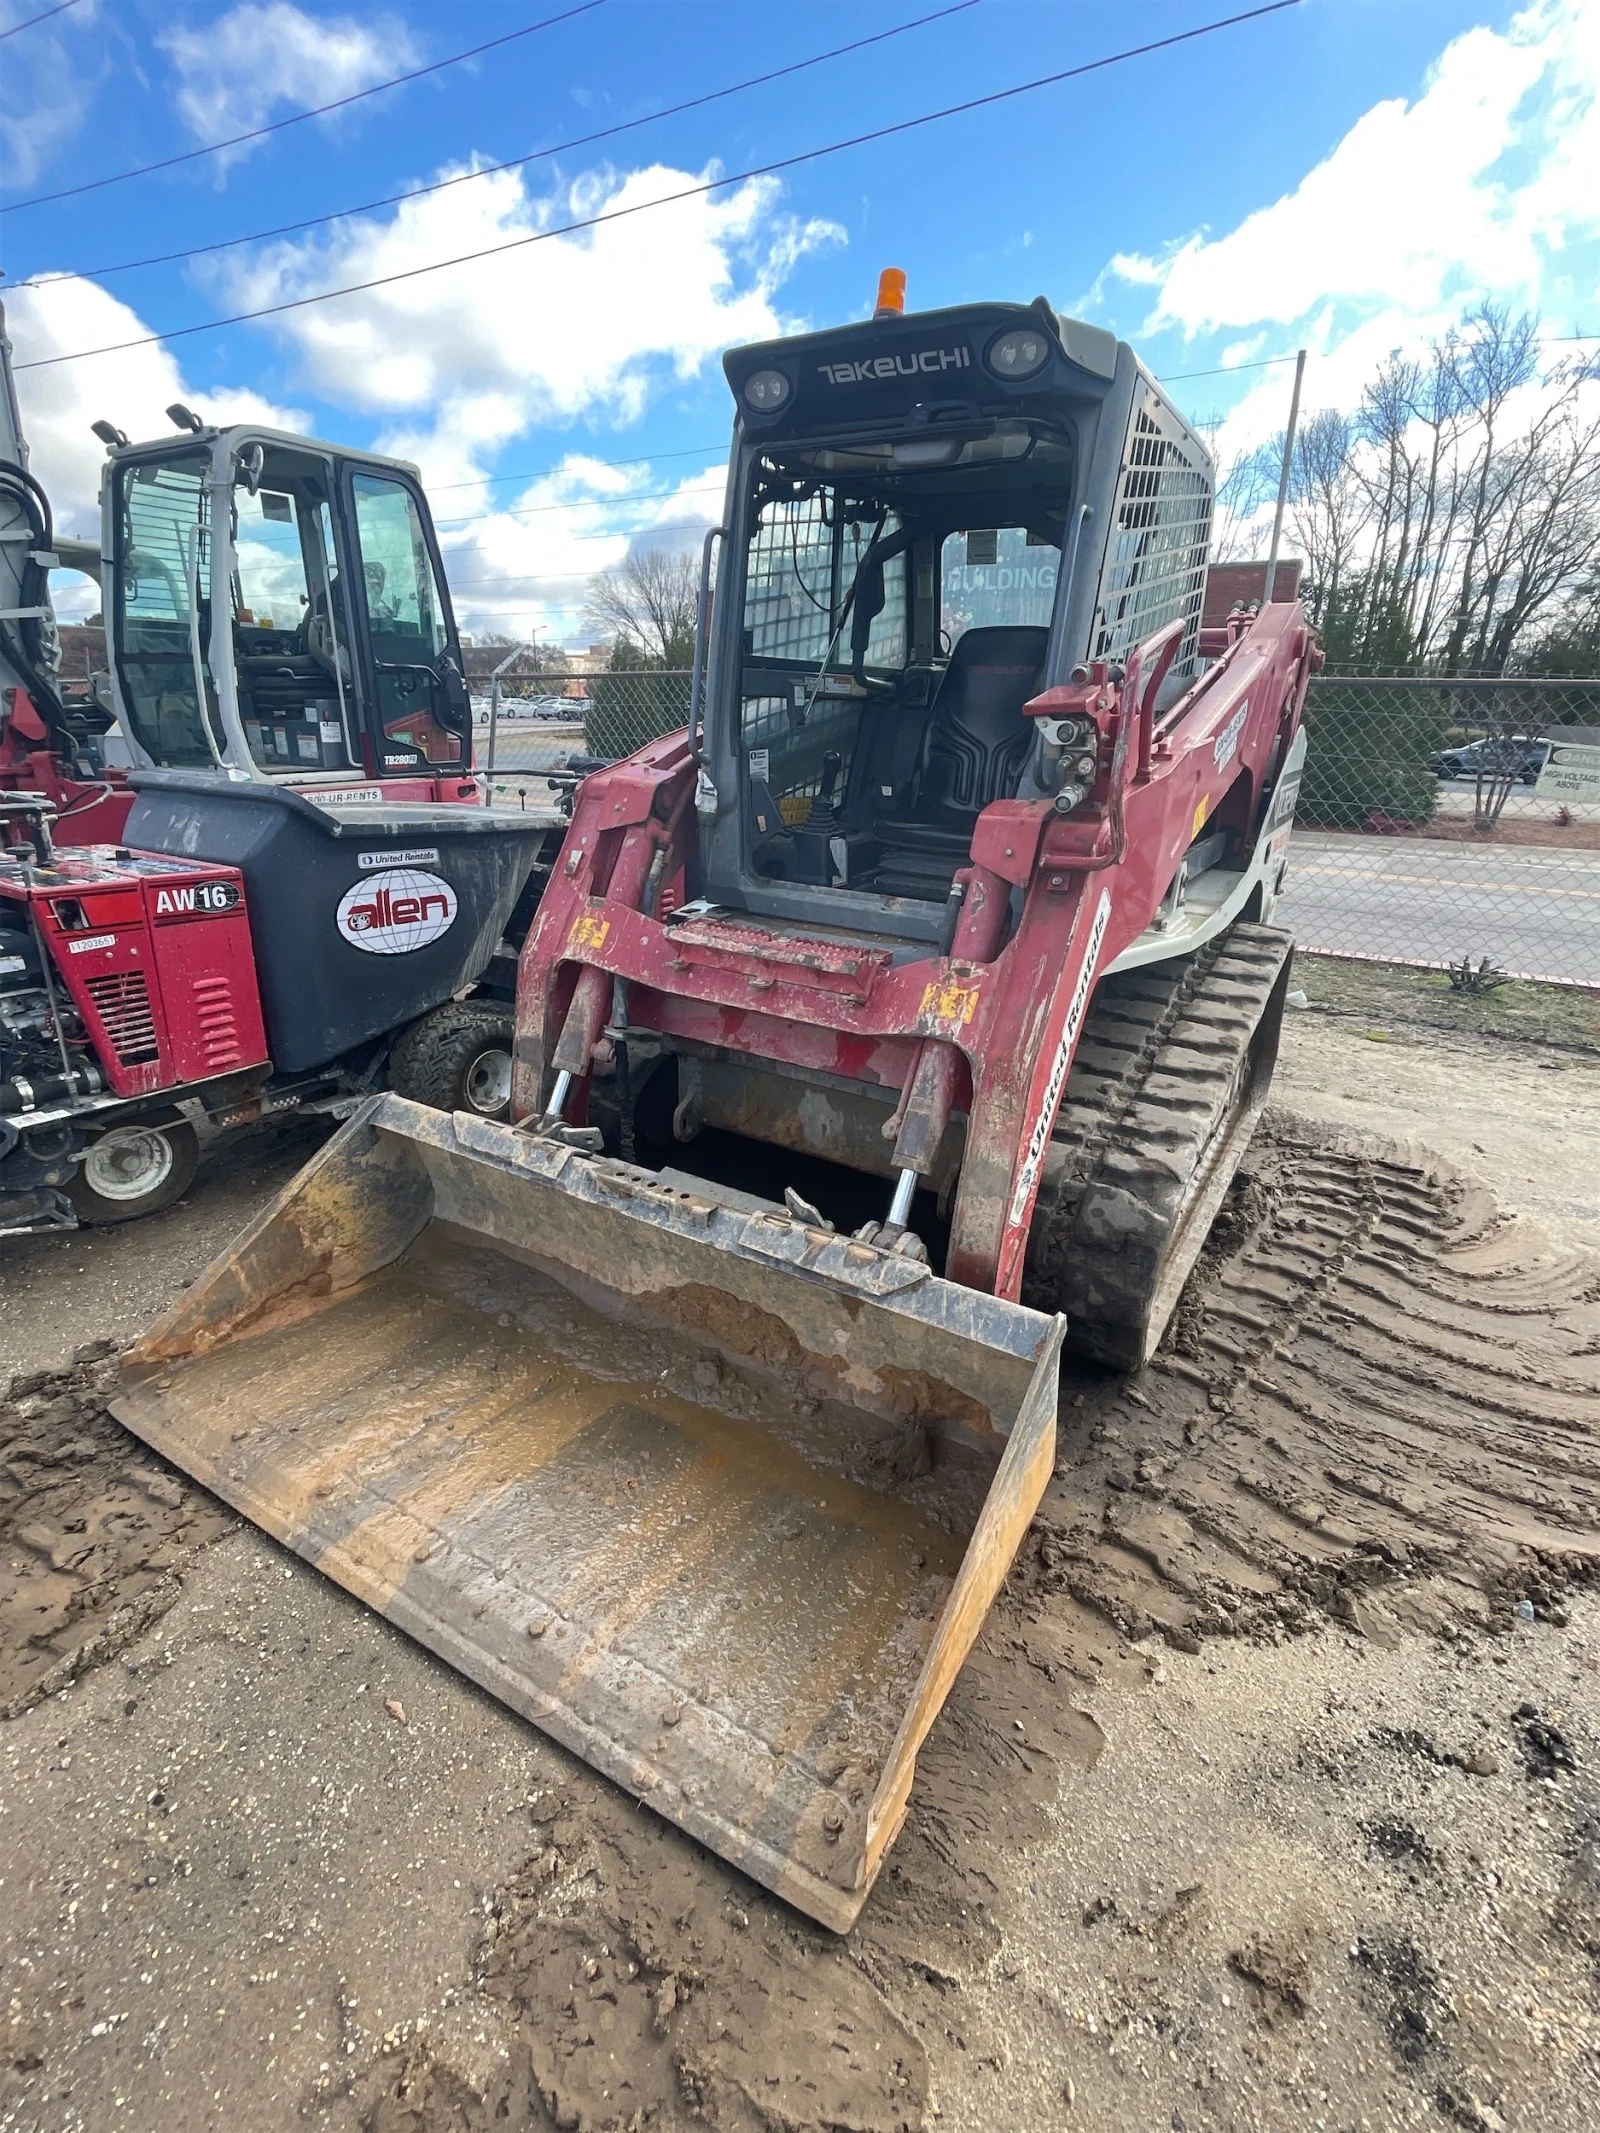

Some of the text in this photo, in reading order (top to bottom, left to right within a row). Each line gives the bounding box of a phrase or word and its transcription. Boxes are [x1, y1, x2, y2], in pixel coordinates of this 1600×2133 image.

[947, 564, 1055, 592] BUILDING
[1544, 770, 1600, 783] HIGH VOLTAGE
[1555, 780, 1581, 790] ABOVE
[375, 851, 434, 864] United Rentals
[348, 888, 449, 932] allen
[1030, 911, 1106, 1162] United Rentals
